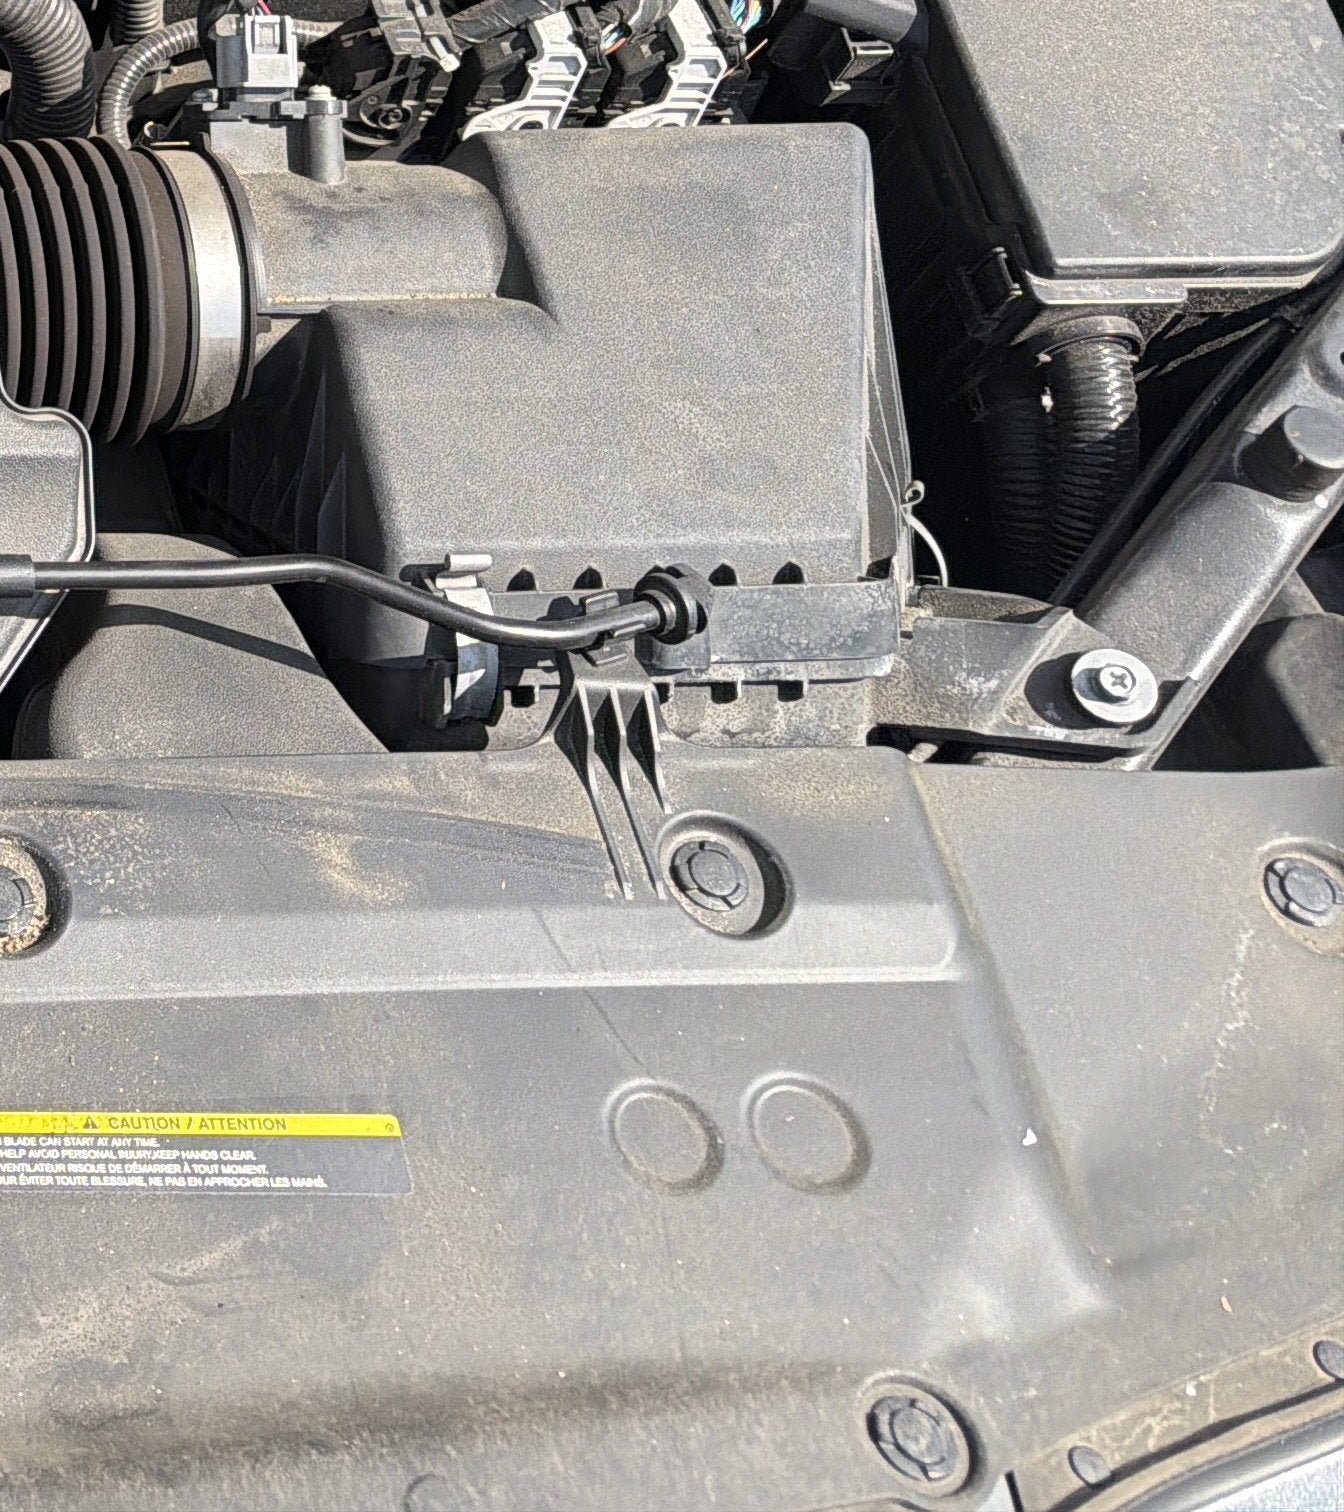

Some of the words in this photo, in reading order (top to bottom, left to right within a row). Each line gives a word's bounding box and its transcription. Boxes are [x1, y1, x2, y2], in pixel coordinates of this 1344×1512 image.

[108, 1116, 180, 1130] CAUTION
[199, 1117, 288, 1131] ATTENTION
[3, 1136, 37, 1147] BLADE
[38, 1136, 61, 1147] CAN
[62, 1136, 95, 1147] START
[96, 1136, 109, 1147] AT
[110, 1136, 132, 1147] ANY
[133, 1136, 160, 1148] TIME.
[0, 1148, 26, 1159] HELP
[28, 1148, 60, 1159] AVOID
[61, 1148, 117, 1160] PERSONAL
[181, 1149, 219, 1160] HANDS
[219, 1150, 257, 1161] CLEAR.
[0, 1162, 66, 1173] VENTILATEUR
[67, 1162, 107, 1174] RISQUE
[108, 1163, 123, 1174] DE
[124, 1160, 182, 1174] DÉMARRER
[182, 1160, 192, 1174] À
[191, 1163, 219, 1174] TOUT
[220, 1164, 269, 1175] MOMENT.
[19, 1172, 54, 1186] ÉVITER
[54, 1175, 89, 1186] TOUTE
[90, 1175, 148, 1187] BLESSURE,
[148, 1176, 164, 1187] NE
[164, 1176, 187, 1187] PAS
[187, 1177, 203, 1187] EN
[203, 1176, 270, 1187] APPROCHER
[270, 1177, 291, 1188] LES
[291, 1175, 328, 1188] MAINS.
